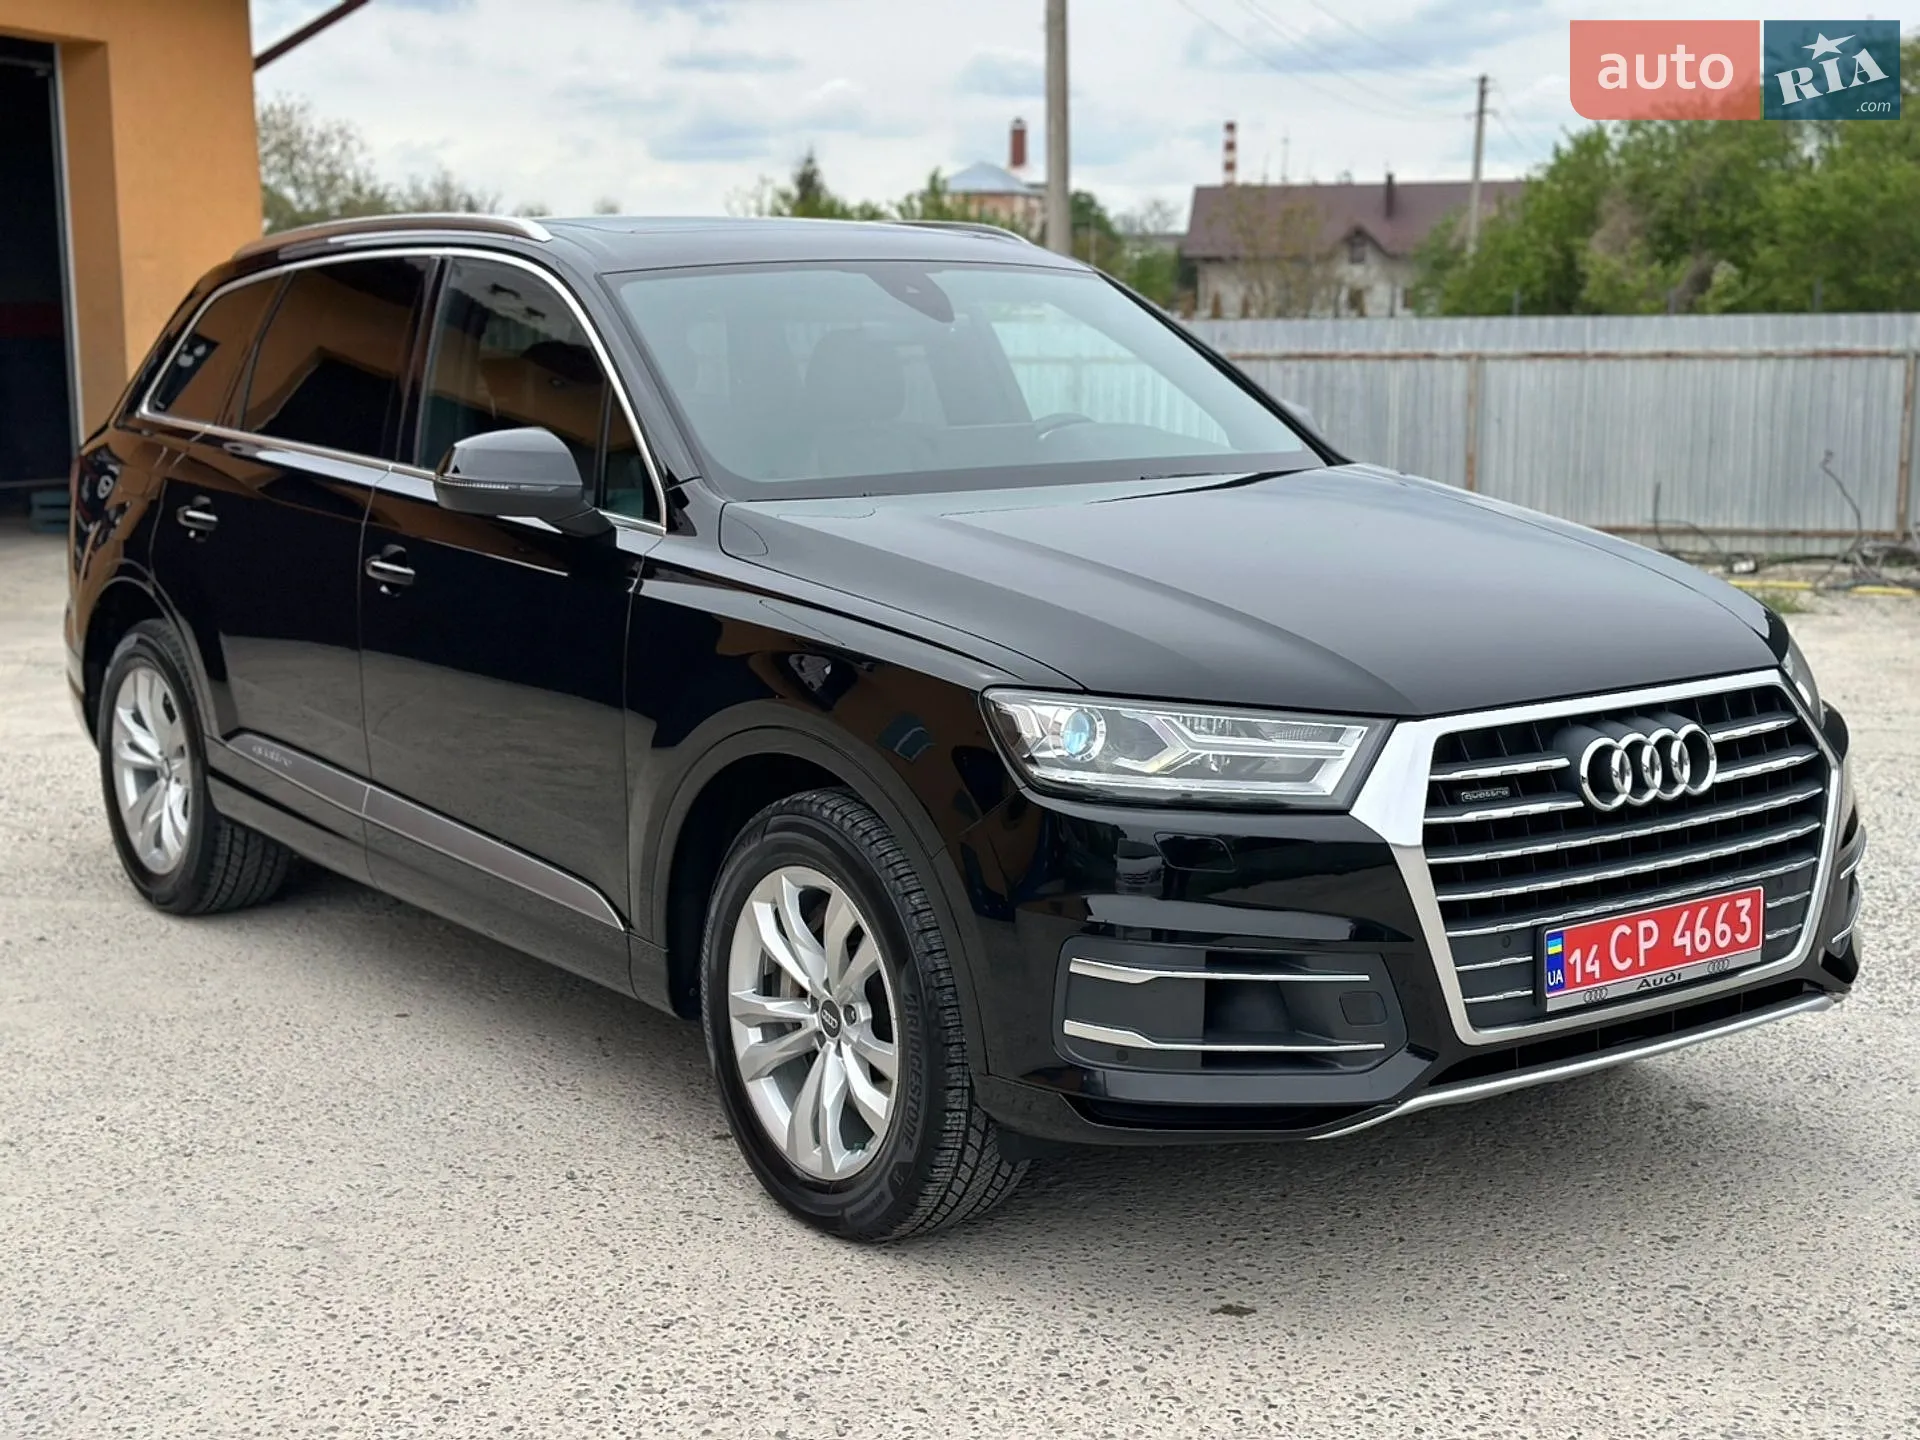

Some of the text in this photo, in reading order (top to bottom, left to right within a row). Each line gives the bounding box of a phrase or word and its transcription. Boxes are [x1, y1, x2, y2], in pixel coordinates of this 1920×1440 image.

[1568, 897, 1753, 983] 14 CP 4663
[1547, 970, 1564, 986] UA
[1636, 972, 1683, 991] Audi
